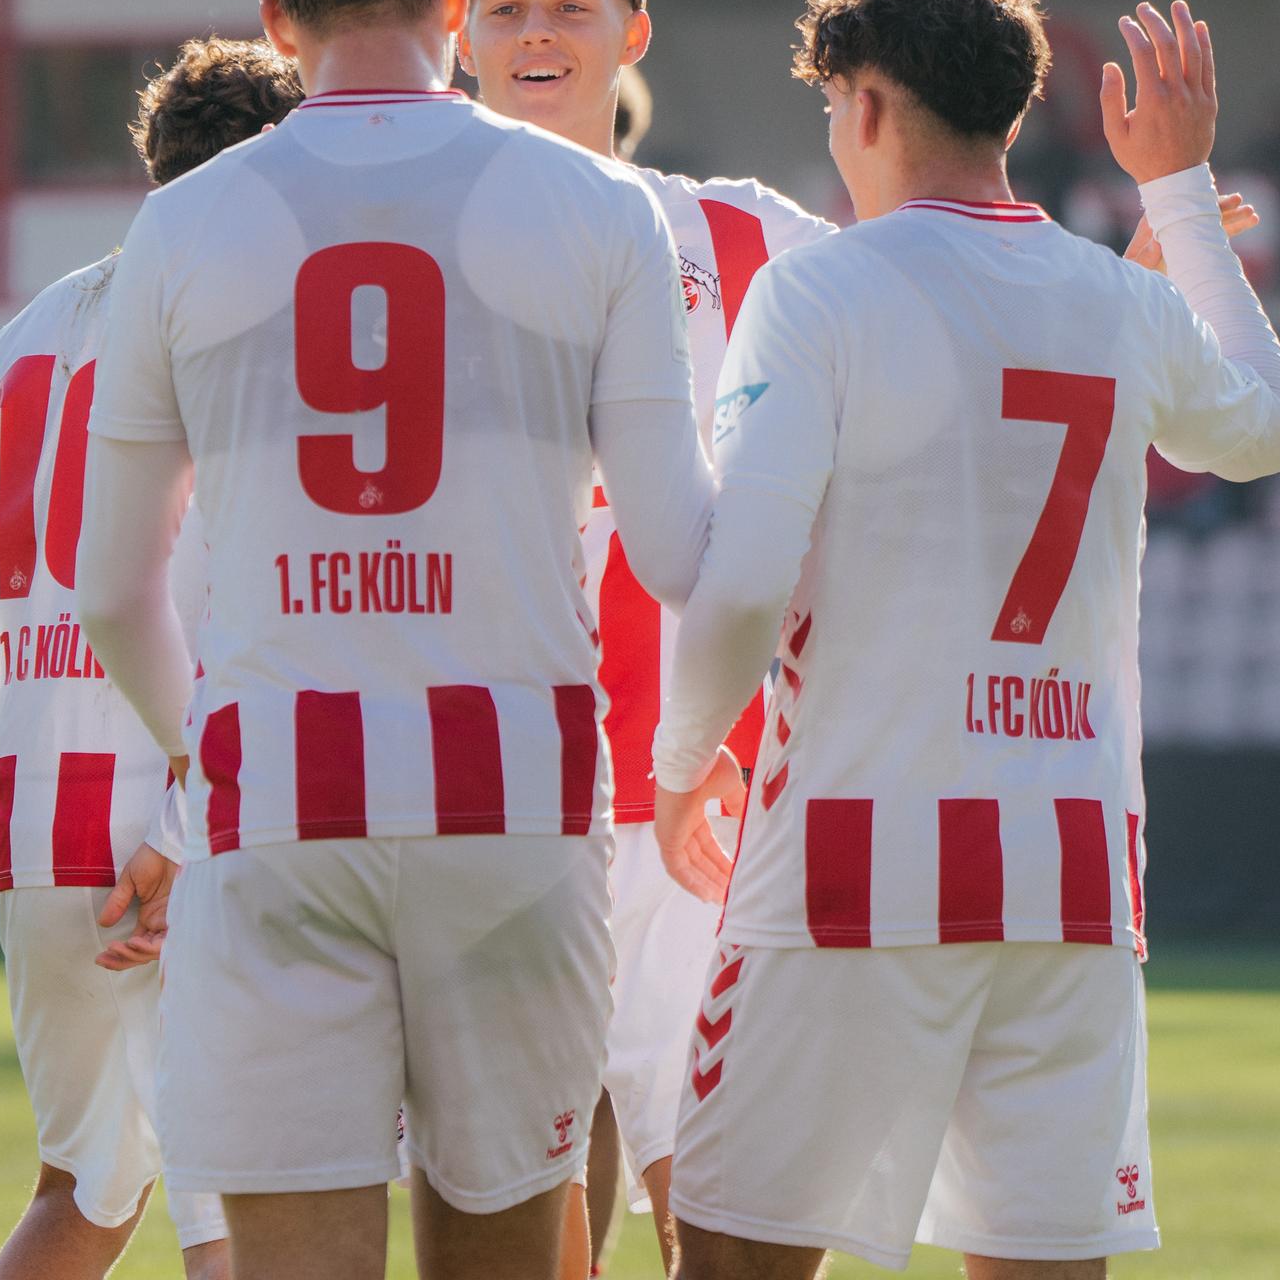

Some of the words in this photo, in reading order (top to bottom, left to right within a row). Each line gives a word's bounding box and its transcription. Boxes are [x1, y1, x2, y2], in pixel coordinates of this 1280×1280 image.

[294, 241, 446, 516] 9
[275, 553, 304, 614] 1.
[310, 551, 353, 614] FC
[357, 539, 453, 615] KÖLN
[990, 367, 1116, 645] 7
[966, 672, 985, 734] 1.
[988, 675, 1025, 738] FC
[1029, 667, 1097, 741] KÖLN
